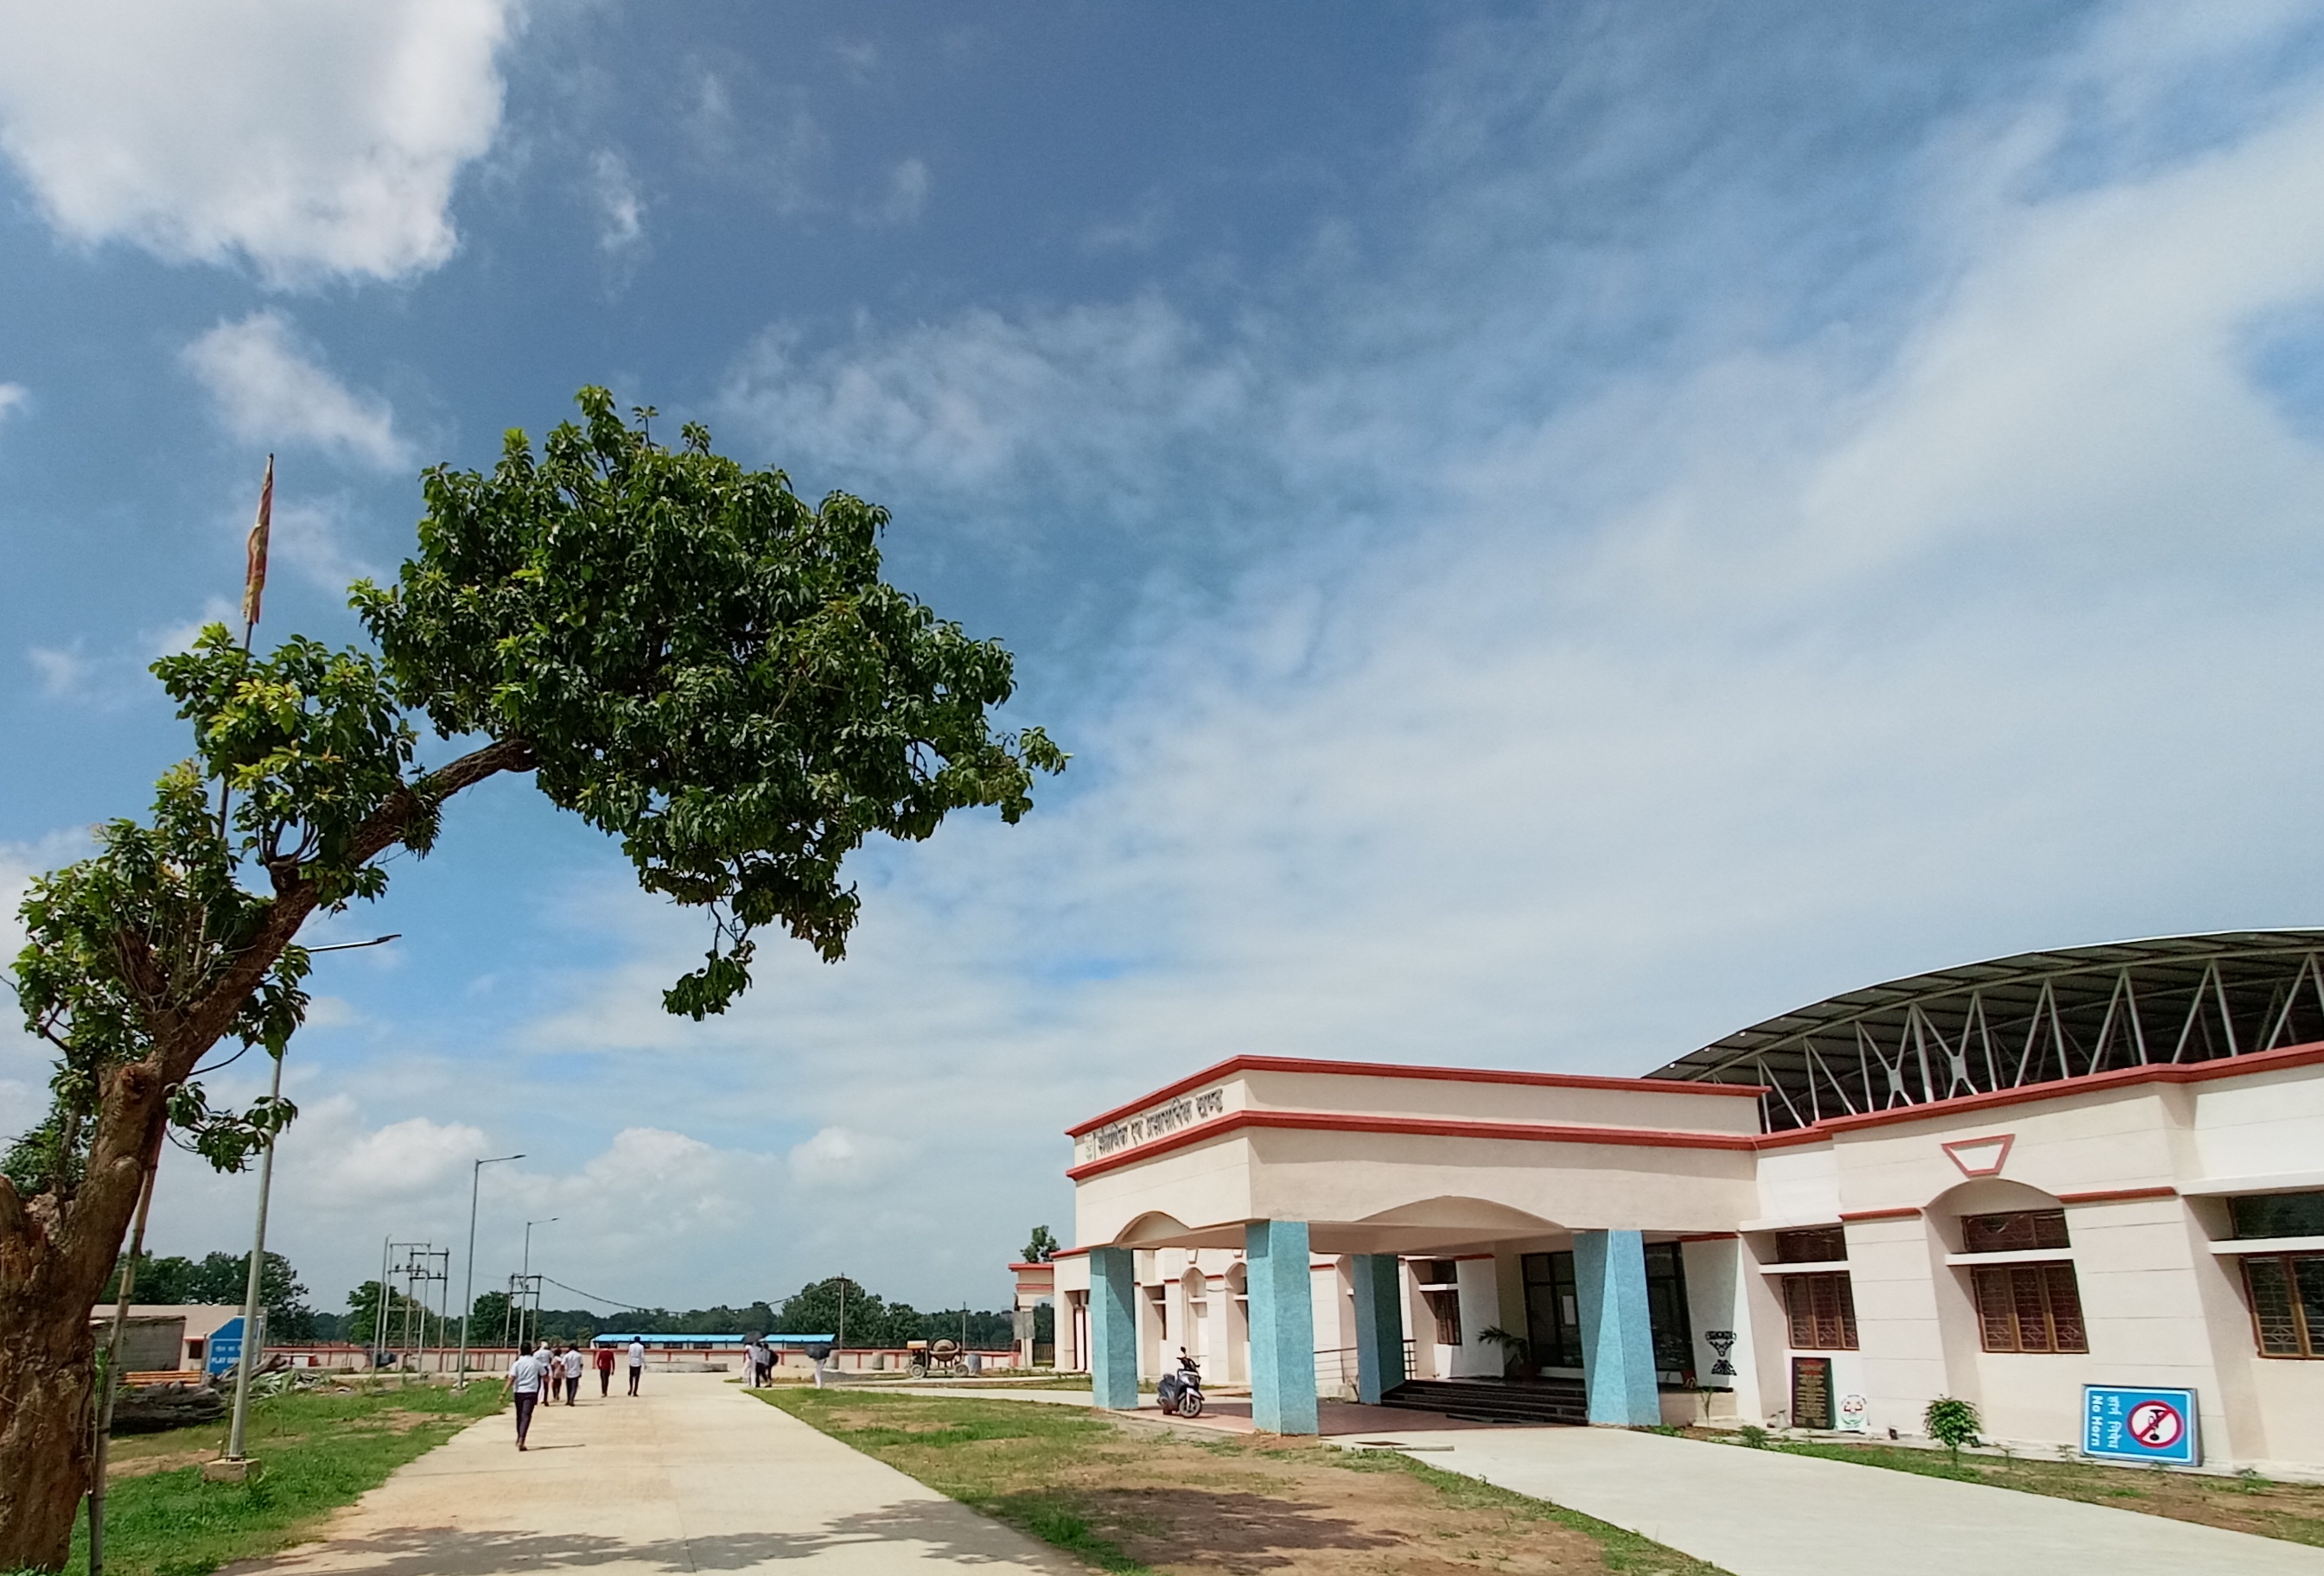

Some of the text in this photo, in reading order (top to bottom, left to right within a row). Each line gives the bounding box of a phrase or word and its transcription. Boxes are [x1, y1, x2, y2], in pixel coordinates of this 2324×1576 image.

[2091, 1395, 2104, 1446] No Horn
[2107, 1420, 2123, 1449] निषेध
